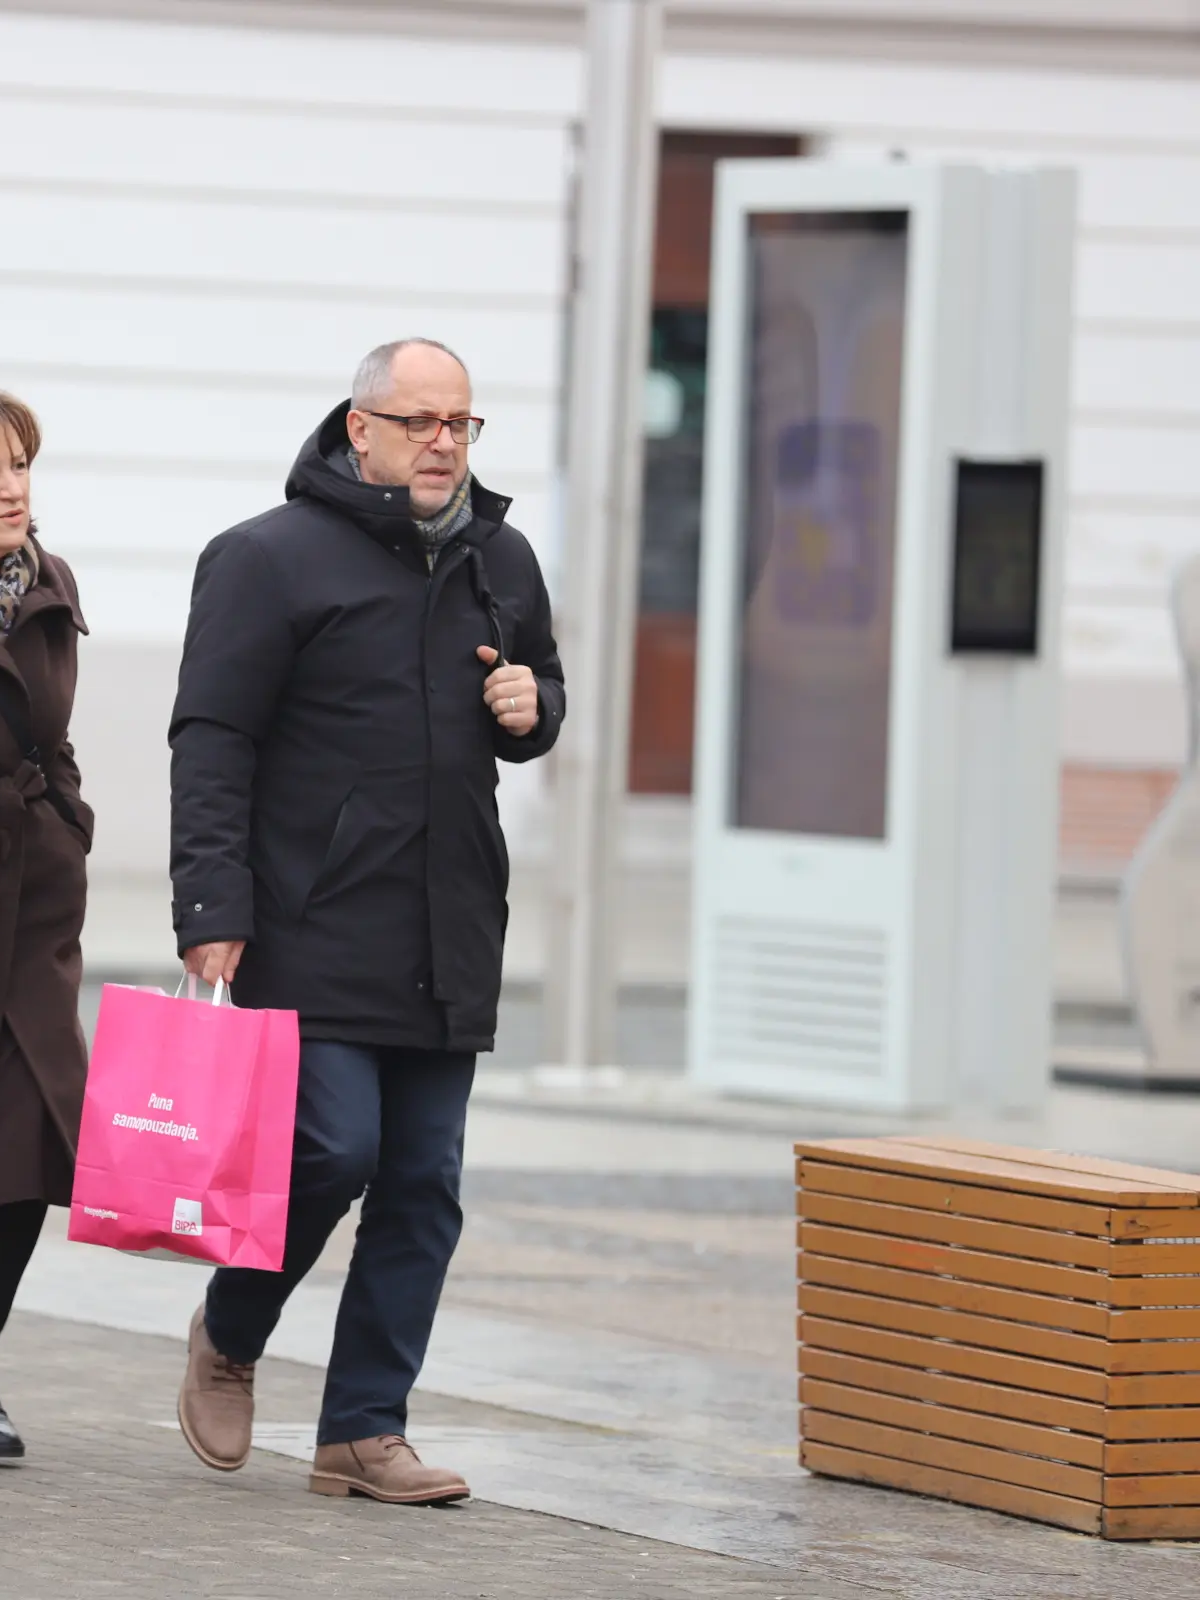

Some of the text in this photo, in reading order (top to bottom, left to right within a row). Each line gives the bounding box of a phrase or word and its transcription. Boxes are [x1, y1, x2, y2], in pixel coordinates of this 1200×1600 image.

[148, 1093, 173, 1111] Puna
[112, 1113, 198, 1141] samopouzdanja.
[175, 1220, 198, 1232] BIPA
